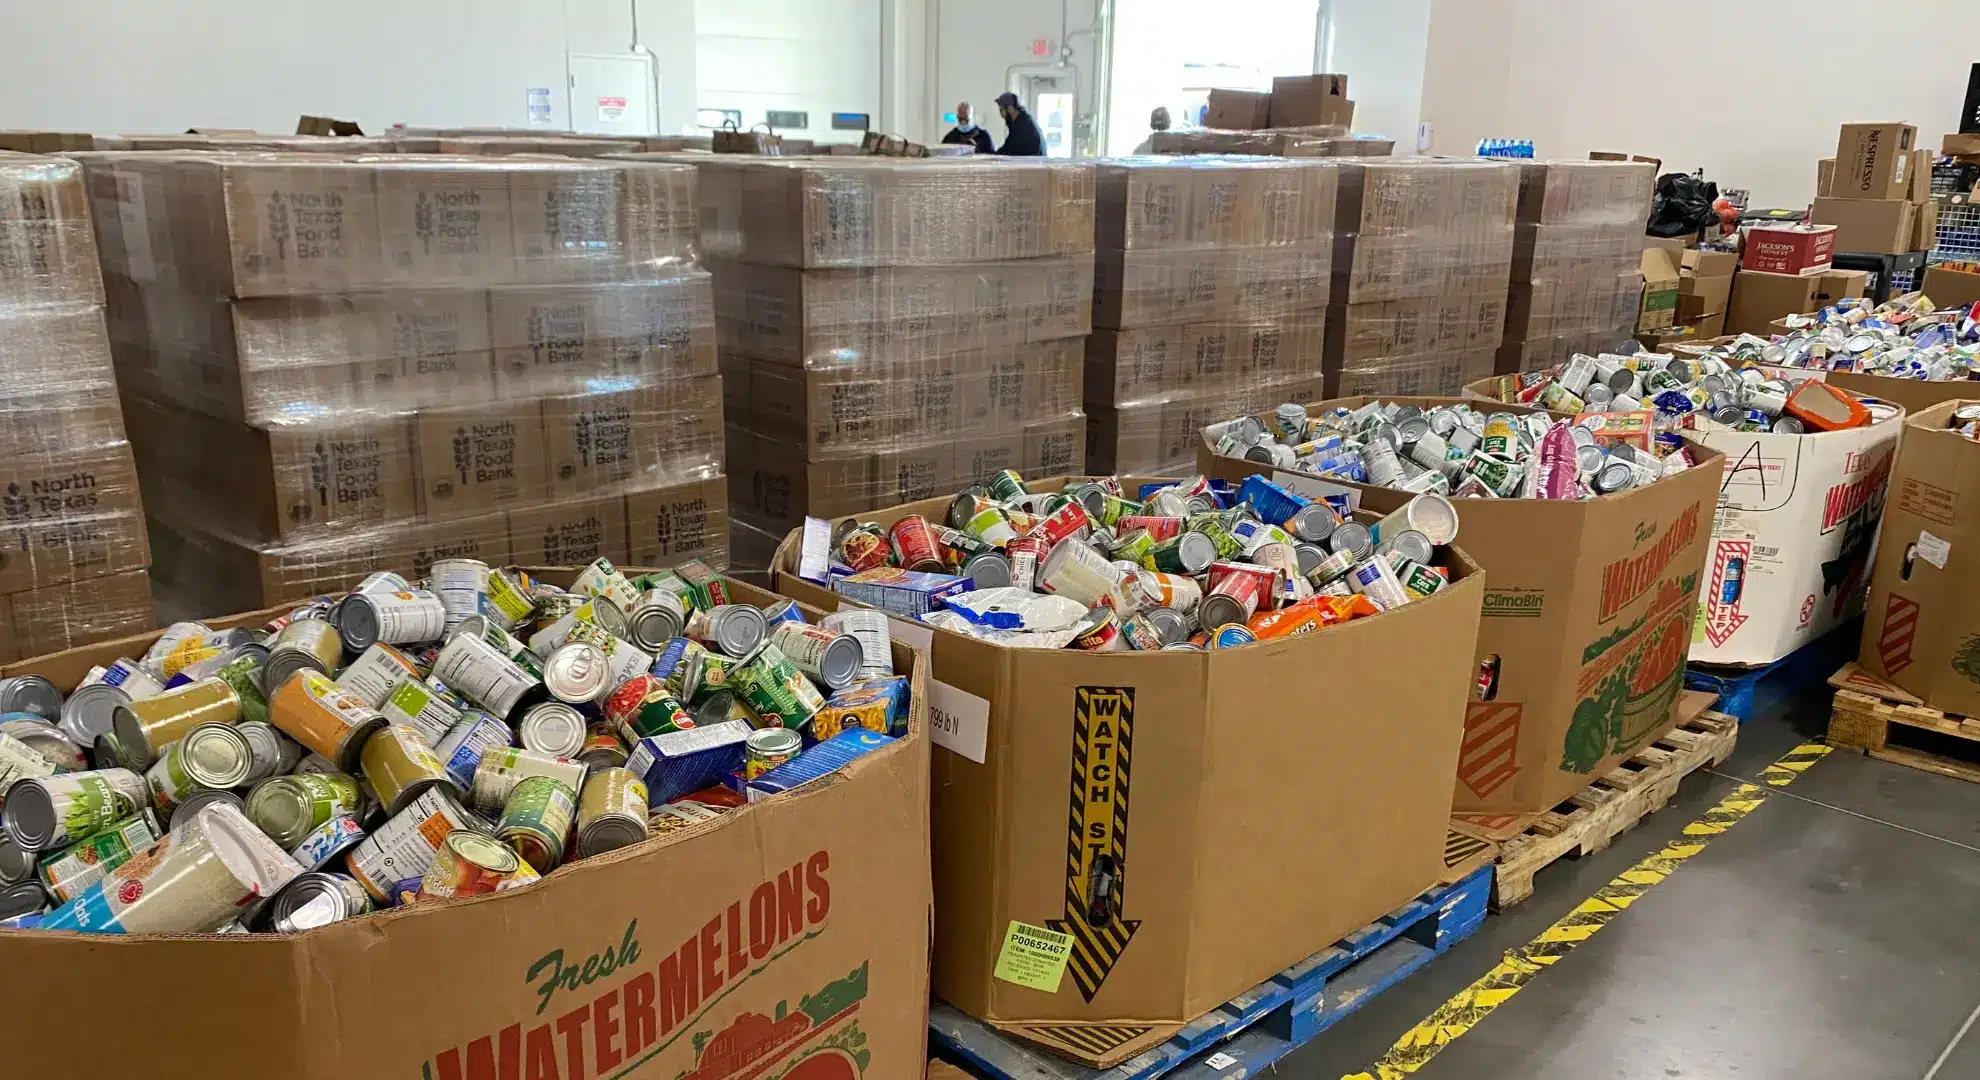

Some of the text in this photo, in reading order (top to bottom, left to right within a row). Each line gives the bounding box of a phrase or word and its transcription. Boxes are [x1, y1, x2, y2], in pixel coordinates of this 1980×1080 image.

[1861, 129, 1882, 191] NESPRESSO
[290, 191, 342, 206] North
[434, 188, 481, 205] North
[293, 208, 342, 223] Texas
[437, 208, 481, 222] Texas
[438, 224, 479, 239] Food
[1756, 242, 1795, 253] JACKSON'S
[1760, 249, 1789, 257] HONEST
[547, 349, 585, 365] Bank
[416, 358, 457, 375] Bank
[592, 406, 631, 422] North
[472, 420, 516, 440] North
[595, 422, 631, 436] Texas
[331, 436, 380, 455] North
[474, 437, 517, 453] Texas
[595, 434, 629, 451] Food
[336, 454, 381, 471] Texas
[475, 451, 514, 468] Food
[595, 450, 629, 465] Bank
[1050, 453, 1071, 465] Food
[336, 468, 378, 488] Food
[476, 466, 516, 483] Bank
[1720, 440, 1766, 502] A
[31, 472, 96, 495] North
[34, 492, 98, 514] Texas
[336, 485, 380, 504] Bank
[672, 497, 707, 514] North
[561, 516, 601, 533] North
[674, 512, 707, 528] Texas
[562, 531, 601, 546] Texas
[675, 538, 705, 556] Bank
[434, 539, 481, 559] North
[563, 546, 600, 563] Food
[1483, 593, 1543, 607] ClimaBin
[929, 706, 944, 729] 799
[944, 712, 951, 732] lb
[1091, 698, 1117, 803] WATCH
[73, 897, 91, 928] Oats
[1010, 933, 1067, 954] P00652467
[525, 917, 642, 1016] Fresh
